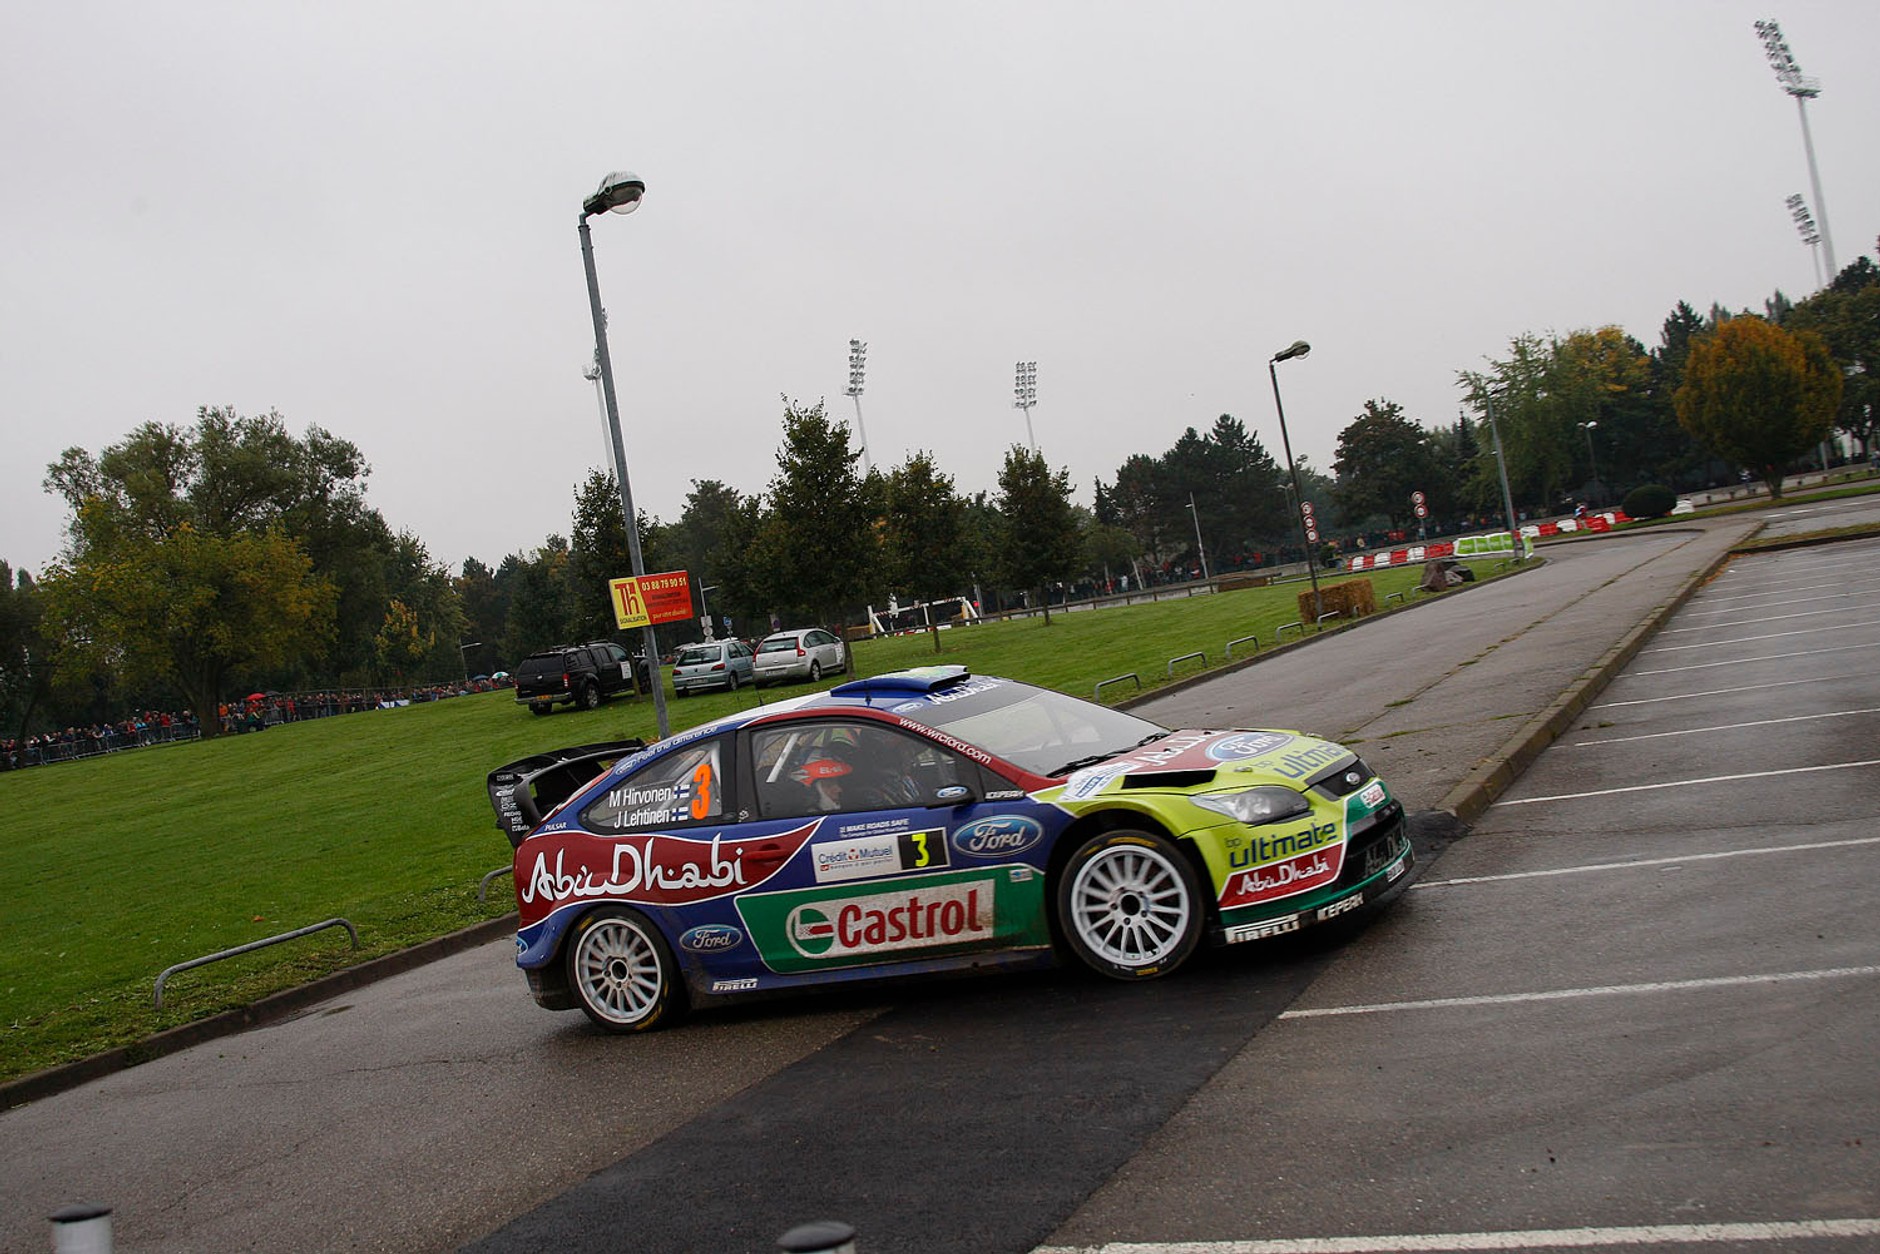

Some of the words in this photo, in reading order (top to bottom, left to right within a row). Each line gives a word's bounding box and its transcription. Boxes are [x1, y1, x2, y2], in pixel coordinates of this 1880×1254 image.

[641, 582, 651, 591] 03
[900, 718, 991, 764] www.wrcford.com
[1273, 743, 1344, 778] ultima
[609, 790, 620, 808] M
[623, 787, 671, 806] Hirvonen
[691, 764, 711, 820] 3
[545, 822, 567, 831] PULSAR
[614, 811, 621, 828] J
[624, 808, 669, 827] Lehtinen
[911, 832, 930, 867] 3
[969, 821, 1027, 851] Ford
[1230, 822, 1338, 868] ultimate
[860, 846, 892, 858] Mutuel
[522, 848, 606, 903] Abu
[605, 832, 748, 895] Dhabi
[838, 888, 983, 948] Castrol
[1224, 913, 1301, 944] PIRELLI
[692, 929, 732, 949] Ford
[713, 977, 758, 991] PIRELLI
